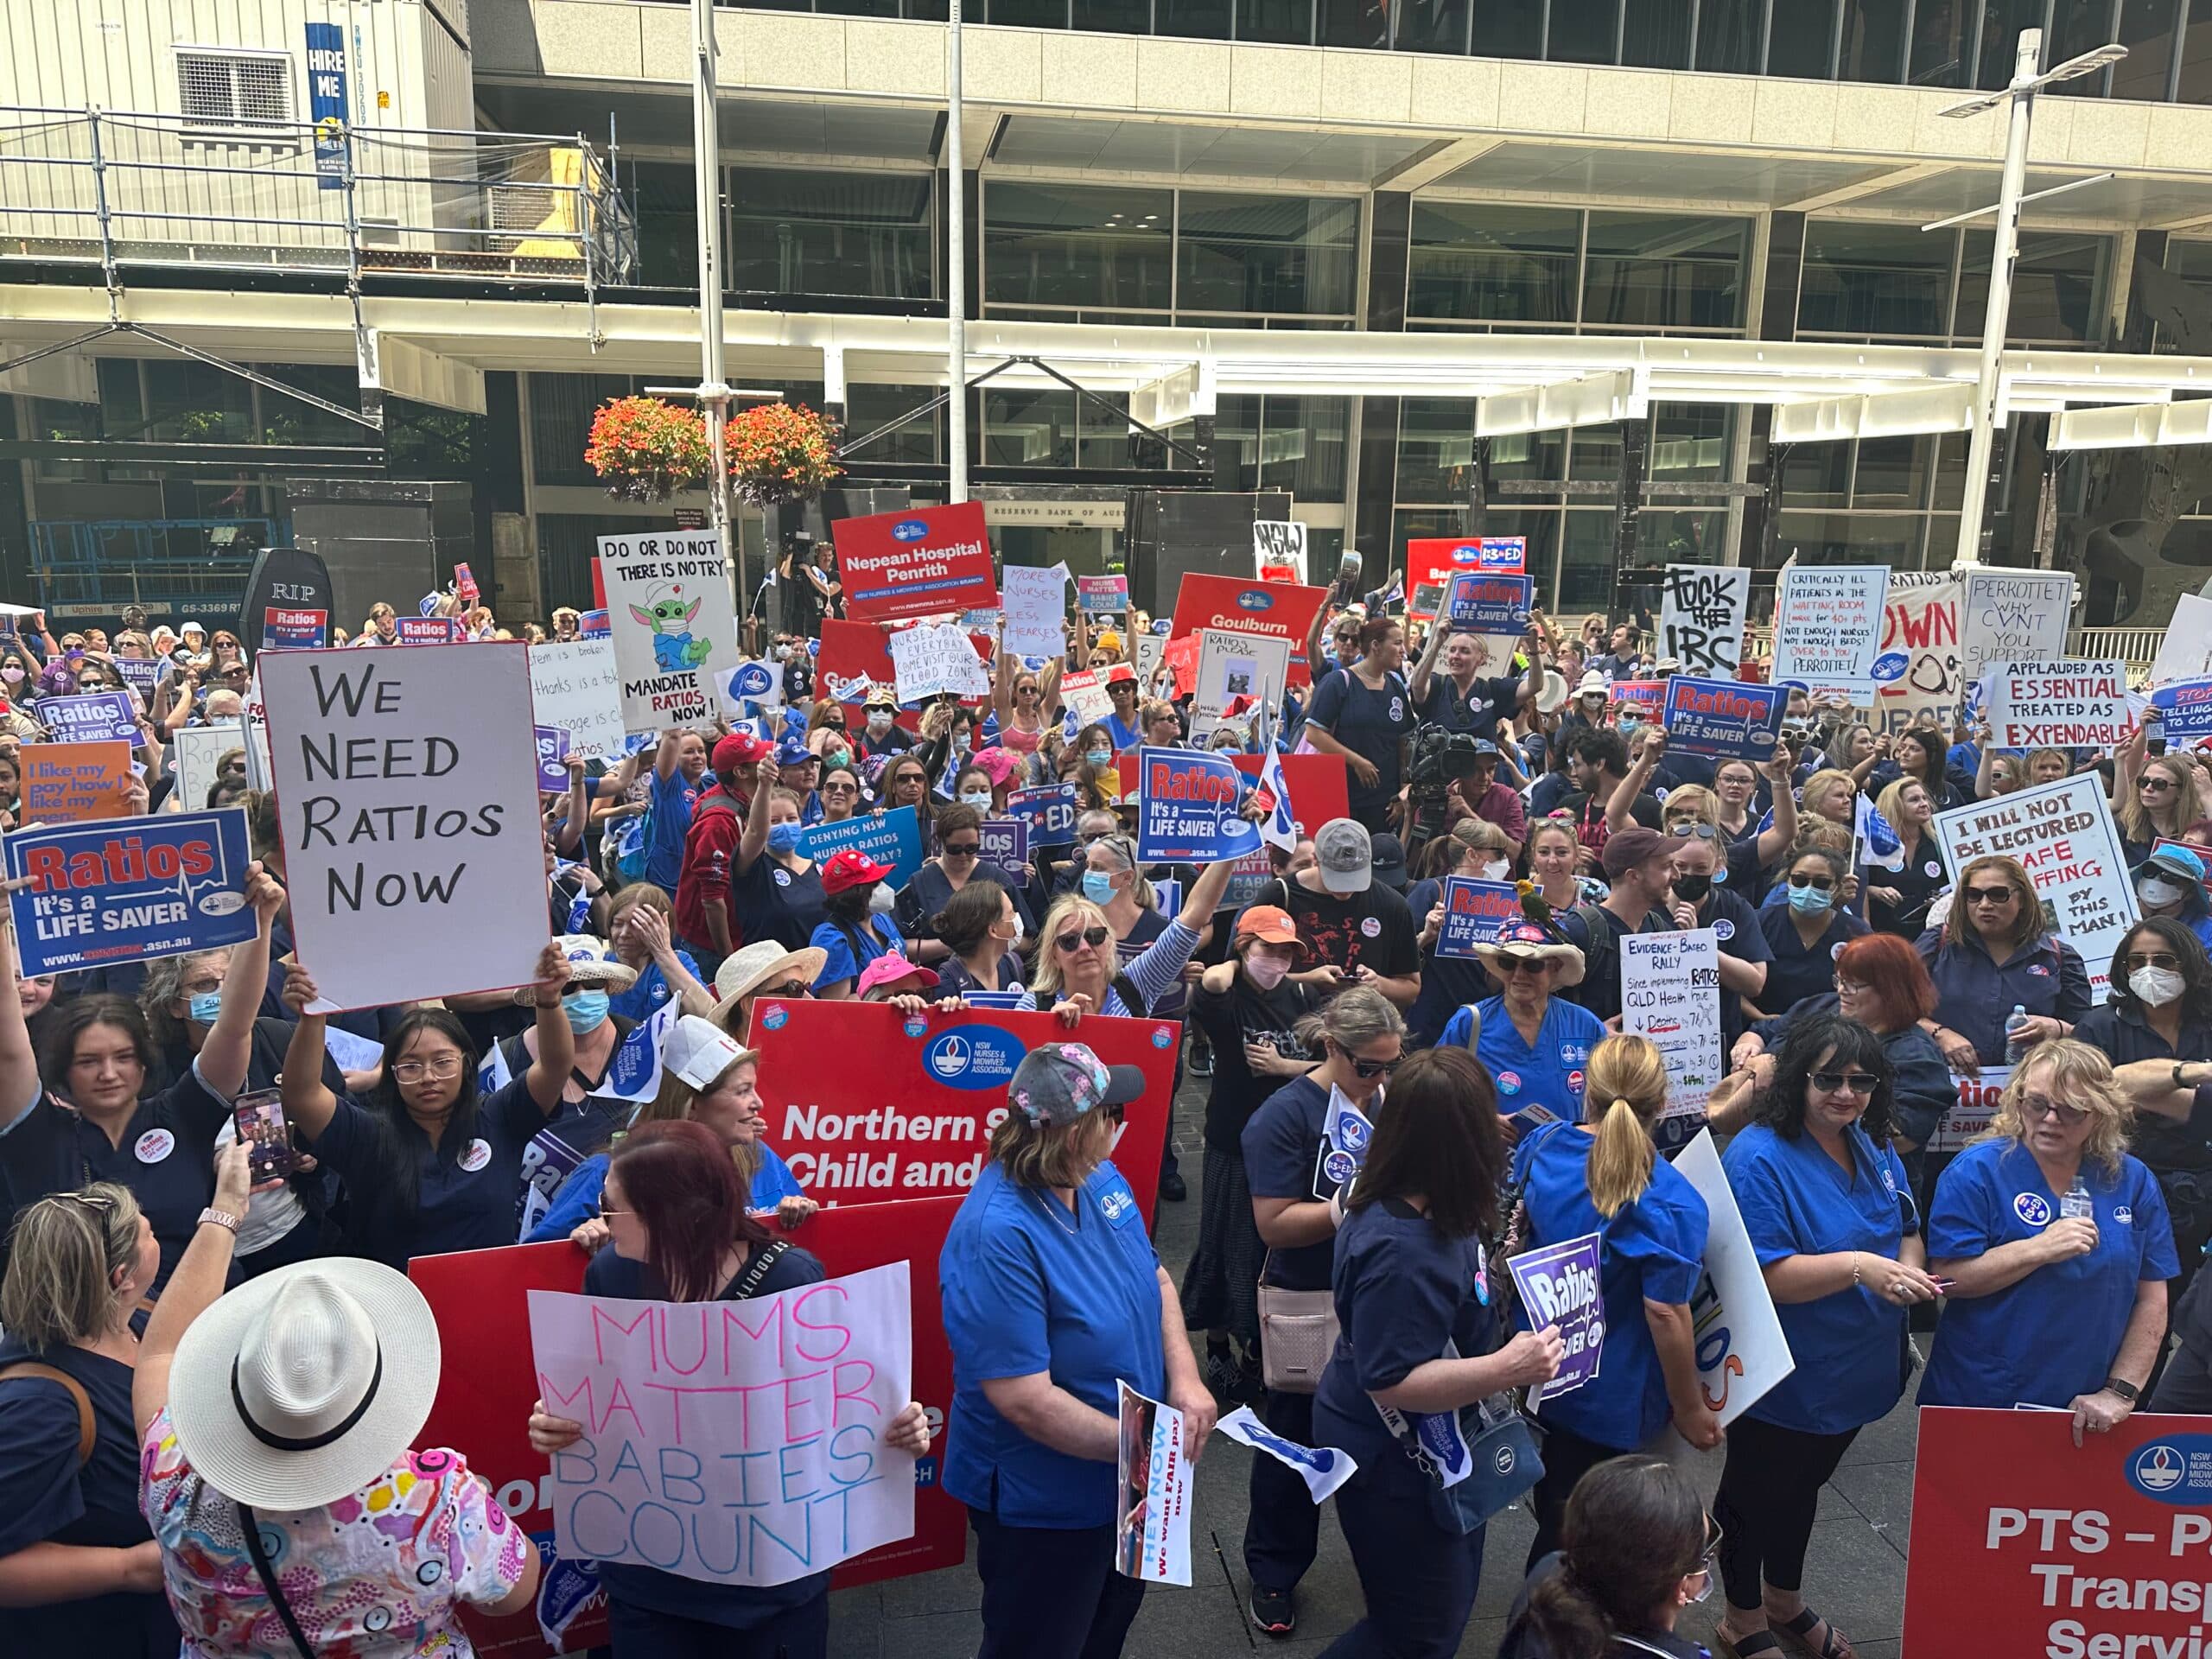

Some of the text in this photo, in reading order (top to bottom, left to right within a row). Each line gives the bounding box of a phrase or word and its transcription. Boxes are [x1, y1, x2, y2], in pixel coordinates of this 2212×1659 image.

[308, 49, 345, 72] HIRE
[317, 75, 340, 98] ME
[606, 540, 717, 557] DO OR DO NOT
[1255, 524, 1302, 555] NSW
[846, 540, 982, 572] Nepean Hospital
[1504, 548, 1522, 561] ED
[617, 560, 725, 581] THERE IS NO TRY
[887, 563, 948, 582] Penrith
[1011, 569, 1046, 583] MORE
[1791, 574, 1866, 585] CRITICALLY ILL
[1889, 572, 1942, 588] RATIOS
[959, 577, 984, 587] BRANCH
[1458, 581, 1522, 602] Ratios
[1974, 580, 2067, 601] PERROTTET
[271, 582, 316, 602] RIP
[1006, 584, 1058, 601] NURSES
[1790, 588, 1868, 599] PATIENTS IN THE
[181, 604, 227, 613] GS-3369
[1455, 601, 1469, 609] It's
[1792, 601, 1866, 612] WAITING ROOM
[1993, 601, 2032, 613] WHY
[276, 611, 317, 625] Ratios
[1006, 610, 1039, 621] LESS
[1211, 614, 1287, 634] Goulburn
[1453, 610, 1509, 622] LIFE SAVER
[1688, 606, 1731, 631] THE
[1816, 613, 1867, 625] for pts
[404, 621, 447, 636] Ratios
[1784, 626, 1836, 638] NOT ENOUGH
[907, 639, 963, 658] EVERYDAY
[1210, 634, 1249, 649] RATIOS
[1666, 625, 1738, 672] IRC
[1783, 637, 1834, 646] NOT ENOUGH
[1993, 632, 2031, 647] YOU
[558, 651, 569, 660] is
[1216, 645, 1259, 657] PLEASE
[1789, 646, 1851, 657] OVER YOU
[1968, 646, 2048, 662] SUPPORT
[897, 652, 974, 676] COME VISIT OUR
[2006, 663, 2114, 677] APPLAUDED AS
[625, 672, 698, 698] MANDATE
[904, 669, 939, 686] FLOOD
[947, 665, 973, 678] ZONE
[309, 664, 402, 718] WE
[534, 677, 599, 696] thanks is a
[1616, 687, 1662, 701] Ratios
[2011, 678, 2125, 700] ESSENTIAL
[652, 690, 705, 711] RATIOS
[1675, 685, 1768, 720] Ratios
[45, 702, 119, 727] Ratios
[1673, 710, 1703, 725] It's a
[2009, 703, 2113, 718] TREATED AS
[1670, 722, 1745, 743] LIFE SAVER
[2168, 718, 2183, 728] TO
[79, 729, 113, 741] SAVER
[300, 733, 459, 782] NEED
[29, 762, 106, 779] I like my
[29, 777, 123, 801] pay how I
[1152, 763, 1236, 804] Ratios
[29, 792, 97, 809] like my
[1150, 802, 1179, 817] It's a
[301, 796, 505, 850] RATIOS
[1046, 804, 1074, 832] ED
[1955, 791, 2073, 838] I WILL NOT
[809, 818, 887, 846] DENYING NSW
[1148, 819, 1216, 837] LIFE SAVER
[1954, 810, 2095, 860] BE LECTURED
[858, 832, 899, 852] RATIOS
[26, 836, 214, 893] Ratios
[327, 861, 467, 914] NOW
[2068, 887, 2093, 905] BY
[32, 895, 97, 918] It's a
[2068, 897, 2109, 918] THIS
[35, 902, 188, 941] LIFE SAVER
[1450, 913, 1475, 927] It's a
[1447, 926, 1471, 940] LIFE
[1652, 956, 1681, 970] RALLY
[1627, 968, 1719, 989] Since implementing RATIOS
[1627, 990, 1686, 1008] QLD Health
[974, 1050, 1006, 1058] NURSES &
[976, 1041, 992, 1050] NSW
[971, 1065, 1013, 1075] ASSOCIATION
[782, 1103, 976, 1141] Northern
[784, 1152, 983, 1189] Child and
[1529, 1262, 1597, 1319] Ratios
[591, 1284, 851, 1376] MUMS
[540, 1360, 881, 1449] MATTER
[2190, 1452, 2211, 1461] NSW
[555, 1425, 876, 1508] BABIES
[1166, 1451, 1177, 1494] FAIR
[1144, 1422, 1166, 1562] HEY NOW
[569, 1476, 884, 1577] COUNT
[1161, 1498, 1171, 1541] want
[1986, 1507, 2110, 1554] PTS
[1159, 1548, 1166, 1577] We
